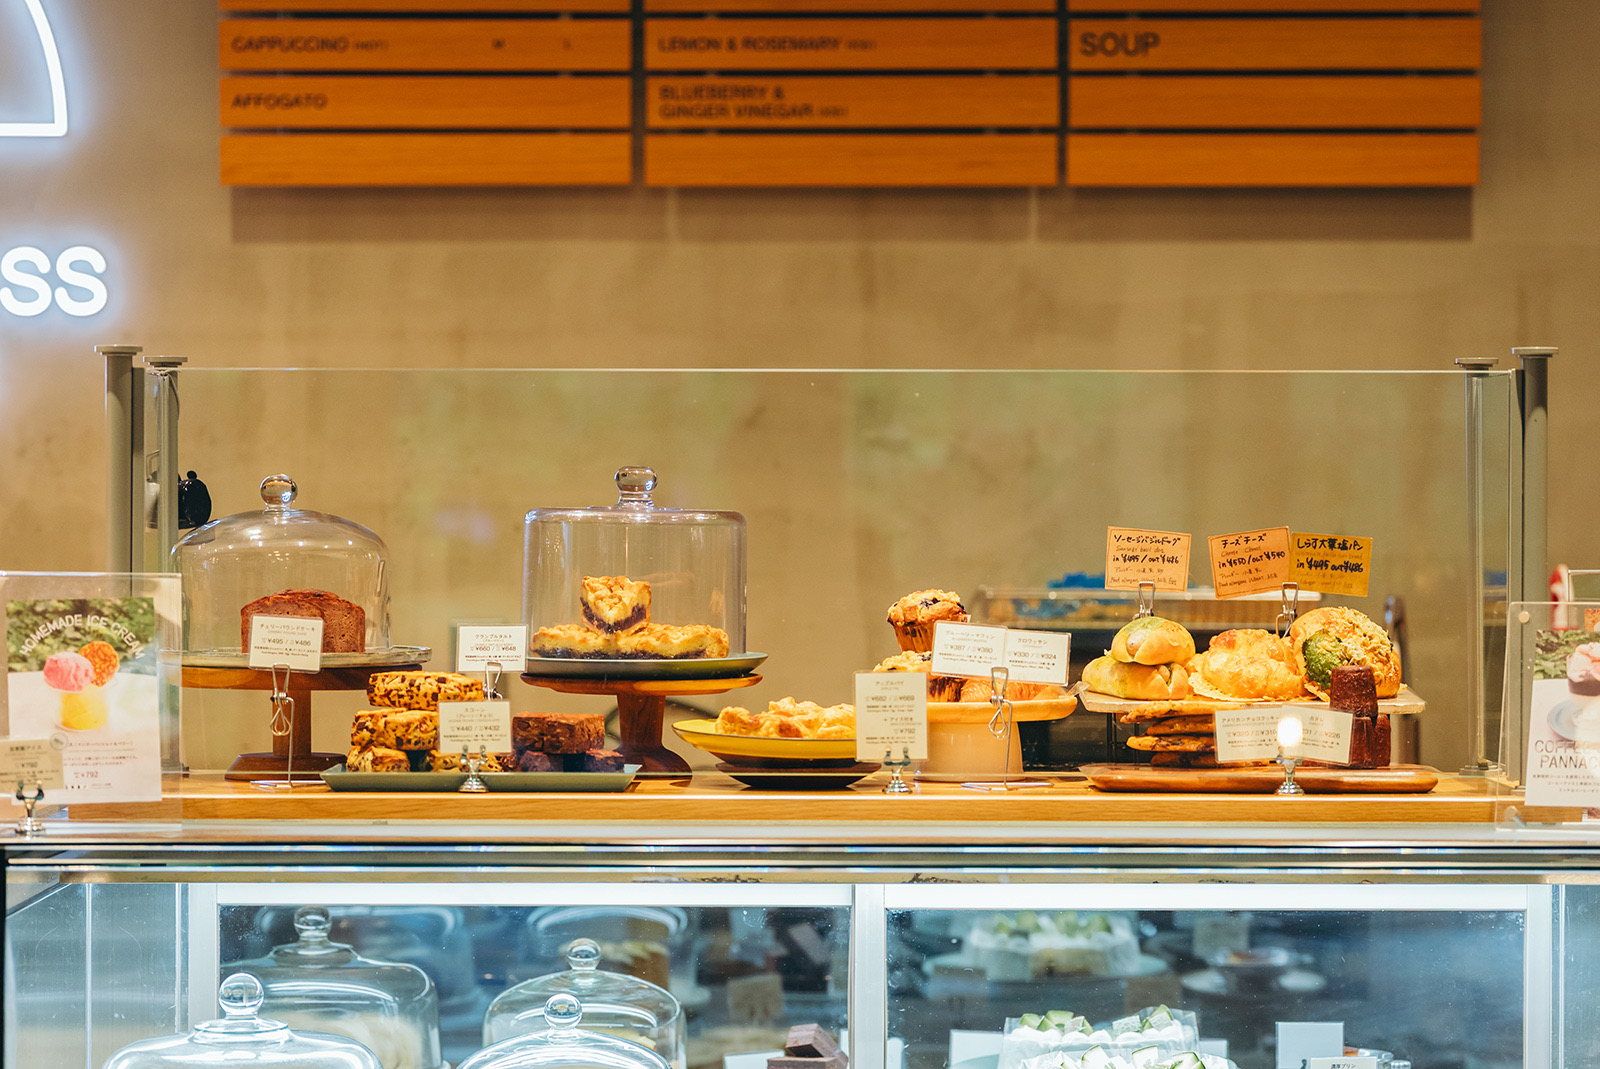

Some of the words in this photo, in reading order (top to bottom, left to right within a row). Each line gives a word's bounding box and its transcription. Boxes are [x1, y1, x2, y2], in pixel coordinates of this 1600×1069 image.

[231, 36, 349, 53] CAPPUCCINO
[658, 36, 722, 51] LEMON
[741, 36, 842, 51] ROSEMARY
[1080, 31, 1160, 57] SOUP
[659, 84, 769, 100] BLUEBERRY
[231, 93, 328, 110] AFFOGATO
[659, 103, 730, 119] GINGER
[733, 103, 814, 119] VINEGAR
[1297, 559, 1305, 568] in
[19, 614, 83, 657] HOMEMADE
[86, 614, 109, 630] ICE
[110, 622, 146, 660] CREAM
